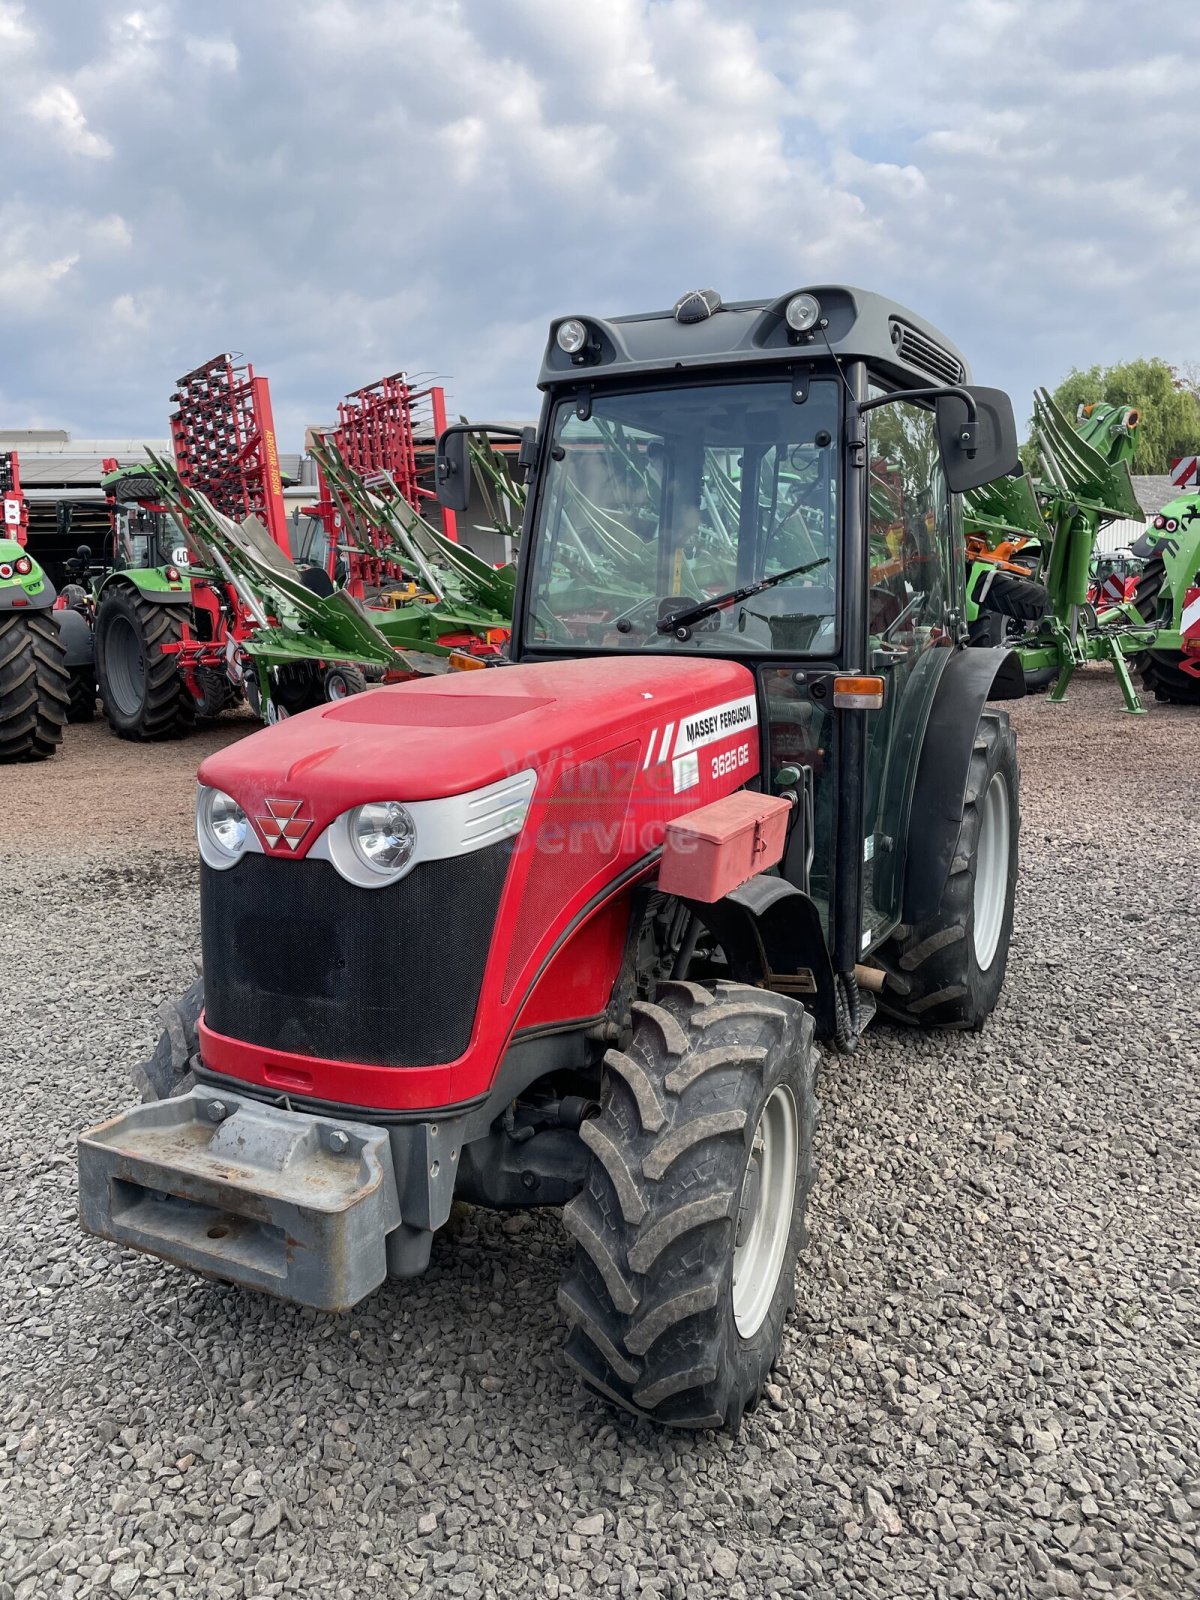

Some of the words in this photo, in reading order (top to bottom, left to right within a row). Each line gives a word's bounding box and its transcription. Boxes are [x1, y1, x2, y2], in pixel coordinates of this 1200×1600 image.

[265, 429, 281, 496] AEROSTAR-FUSION
[177, 551, 188, 563] 40
[686, 715, 718, 742] MASSEY
[720, 704, 752, 729] FERGUSON
[711, 749, 737, 779] 3625
[738, 743, 749, 767] GE
